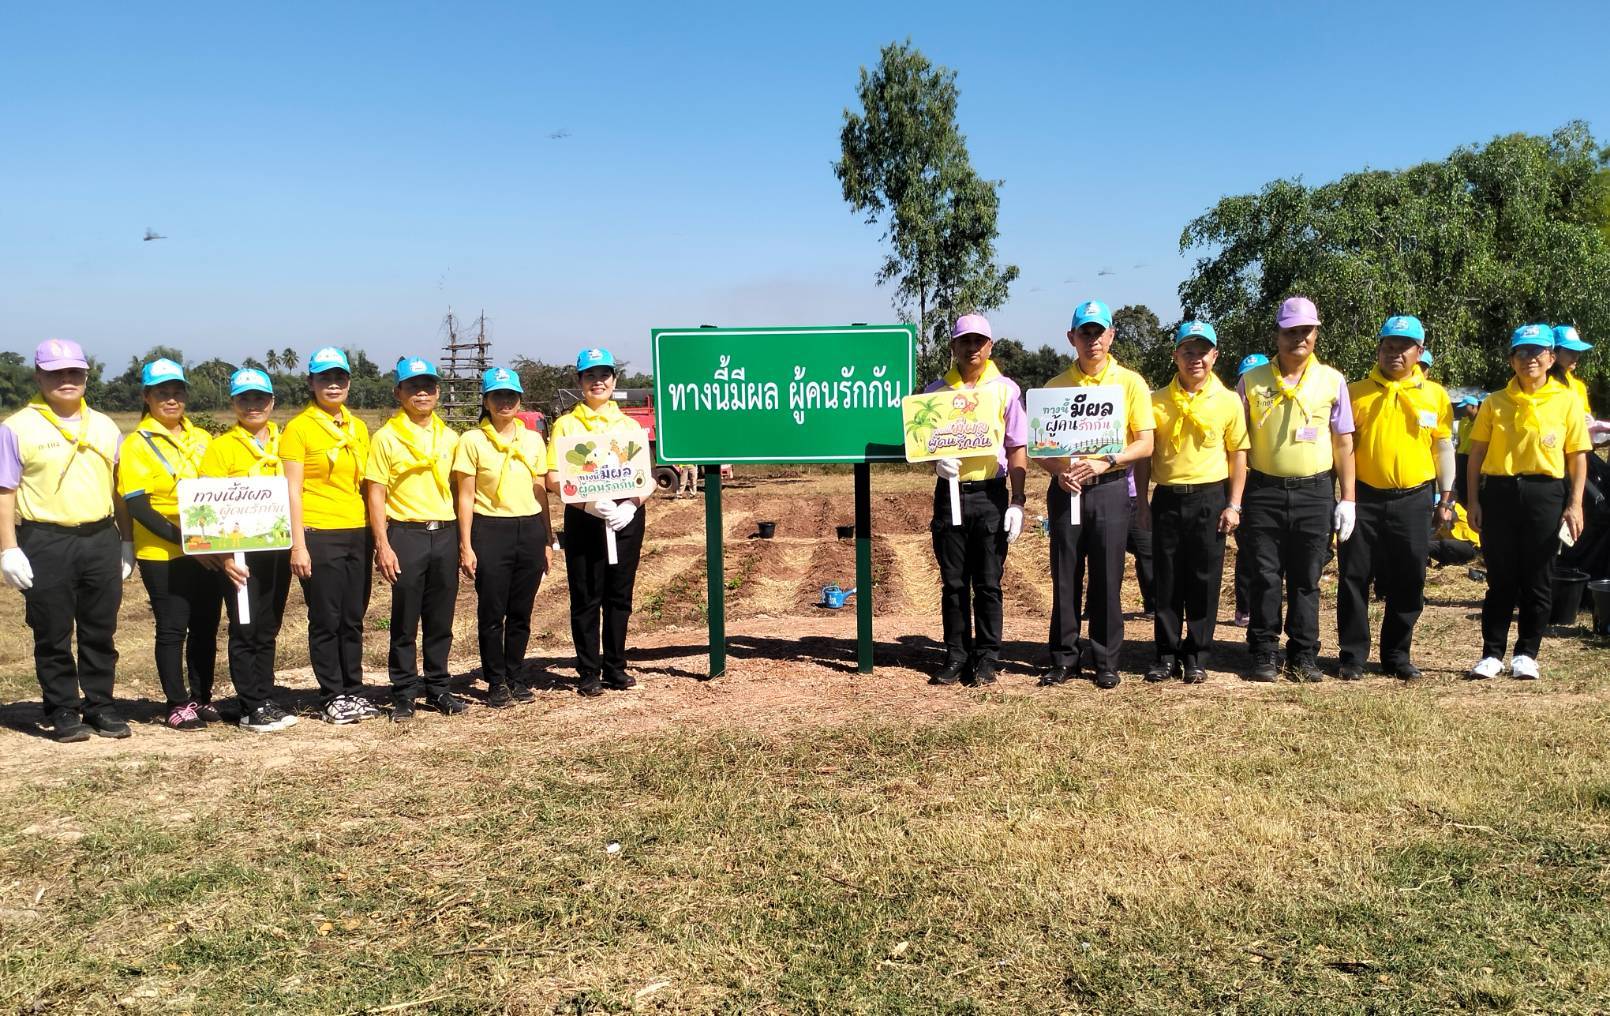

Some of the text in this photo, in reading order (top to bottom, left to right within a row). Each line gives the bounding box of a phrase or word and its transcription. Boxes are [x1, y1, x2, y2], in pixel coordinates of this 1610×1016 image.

[668, 354, 901, 425] ทางนี้มีผล ผู้คนรักกัน
[1046, 414, 1111, 438] ผู้คนรักกัน
[193, 481, 273, 504] ทางนี้มีผล
